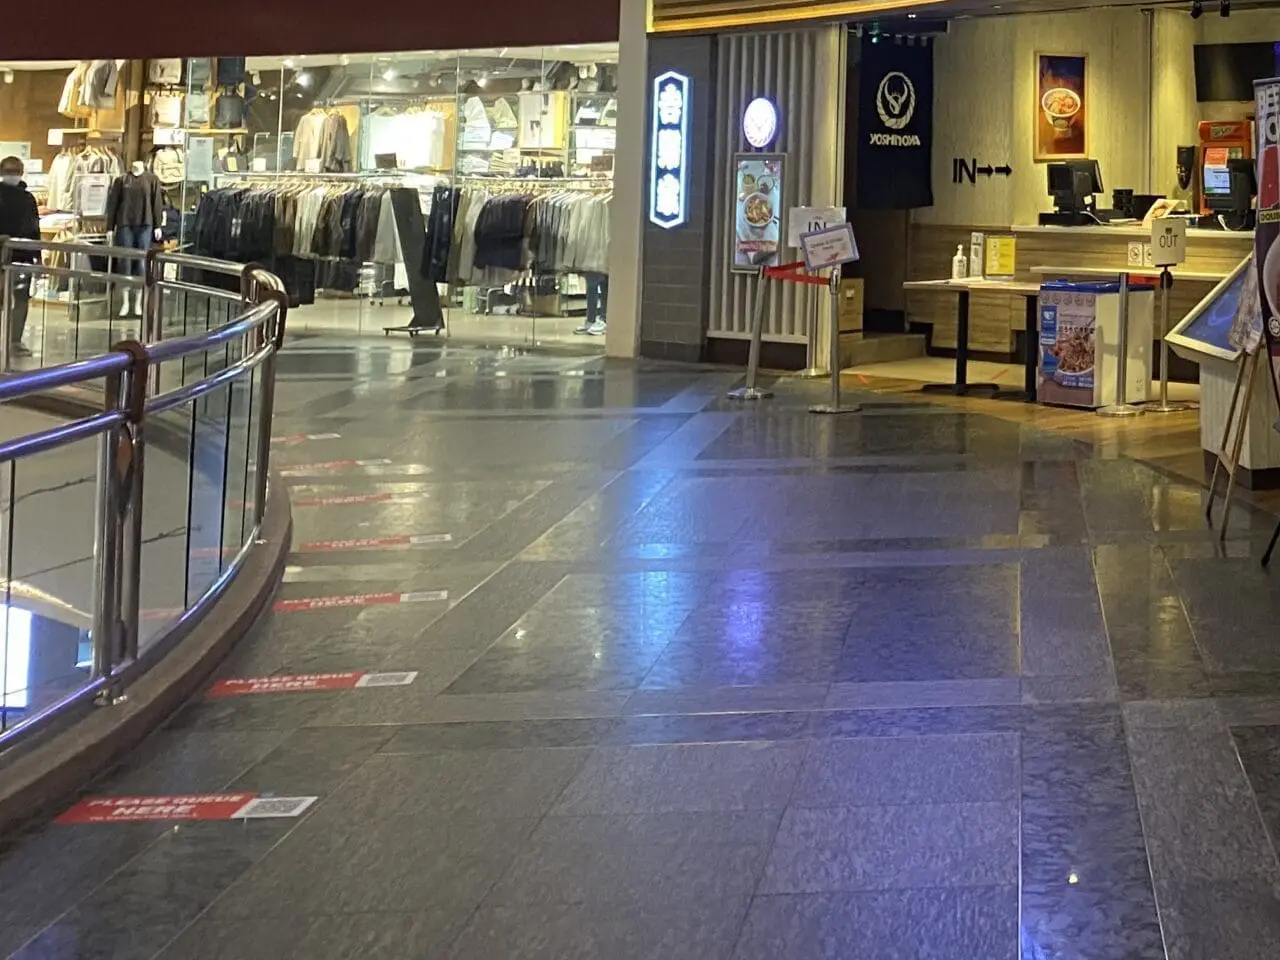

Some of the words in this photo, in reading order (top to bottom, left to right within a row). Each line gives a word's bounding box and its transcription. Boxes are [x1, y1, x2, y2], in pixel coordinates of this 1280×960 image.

[869, 133, 921, 147] YOSHINOYA
[953, 157, 977, 184] IN
[1159, 234, 1178, 249] OUT
[112, 804, 197, 817] HERE
